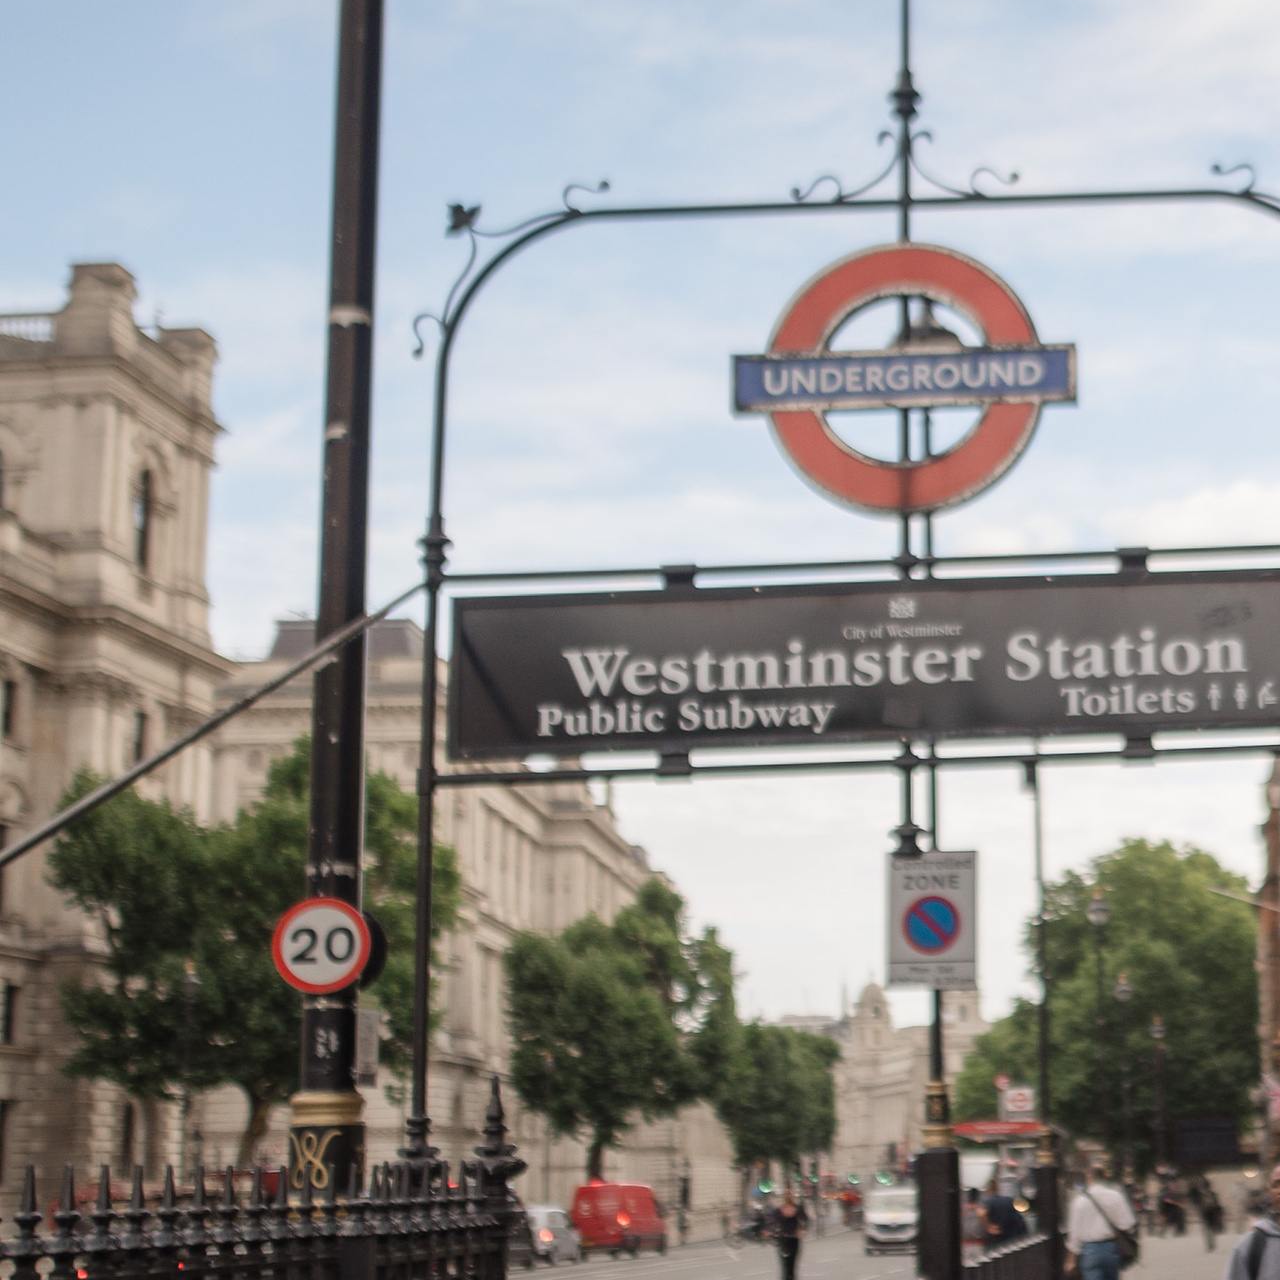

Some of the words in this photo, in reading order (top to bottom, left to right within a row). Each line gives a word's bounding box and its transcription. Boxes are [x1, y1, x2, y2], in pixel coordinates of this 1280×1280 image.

[763, 360, 1044, 396] UNDERGROUND
[843, 626, 867, 642] City
[870, 624, 884, 639] of
[885, 624, 962, 638] Westminster
[562, 638, 983, 698] Westminster
[1005, 629, 1247, 681] Station
[537, 699, 665, 736] Public
[678, 695, 836, 734] Subway
[1060, 683, 1196, 717] Toilets
[903, 874, 960, 890] ZONE
[291, 927, 355, 964] 20
